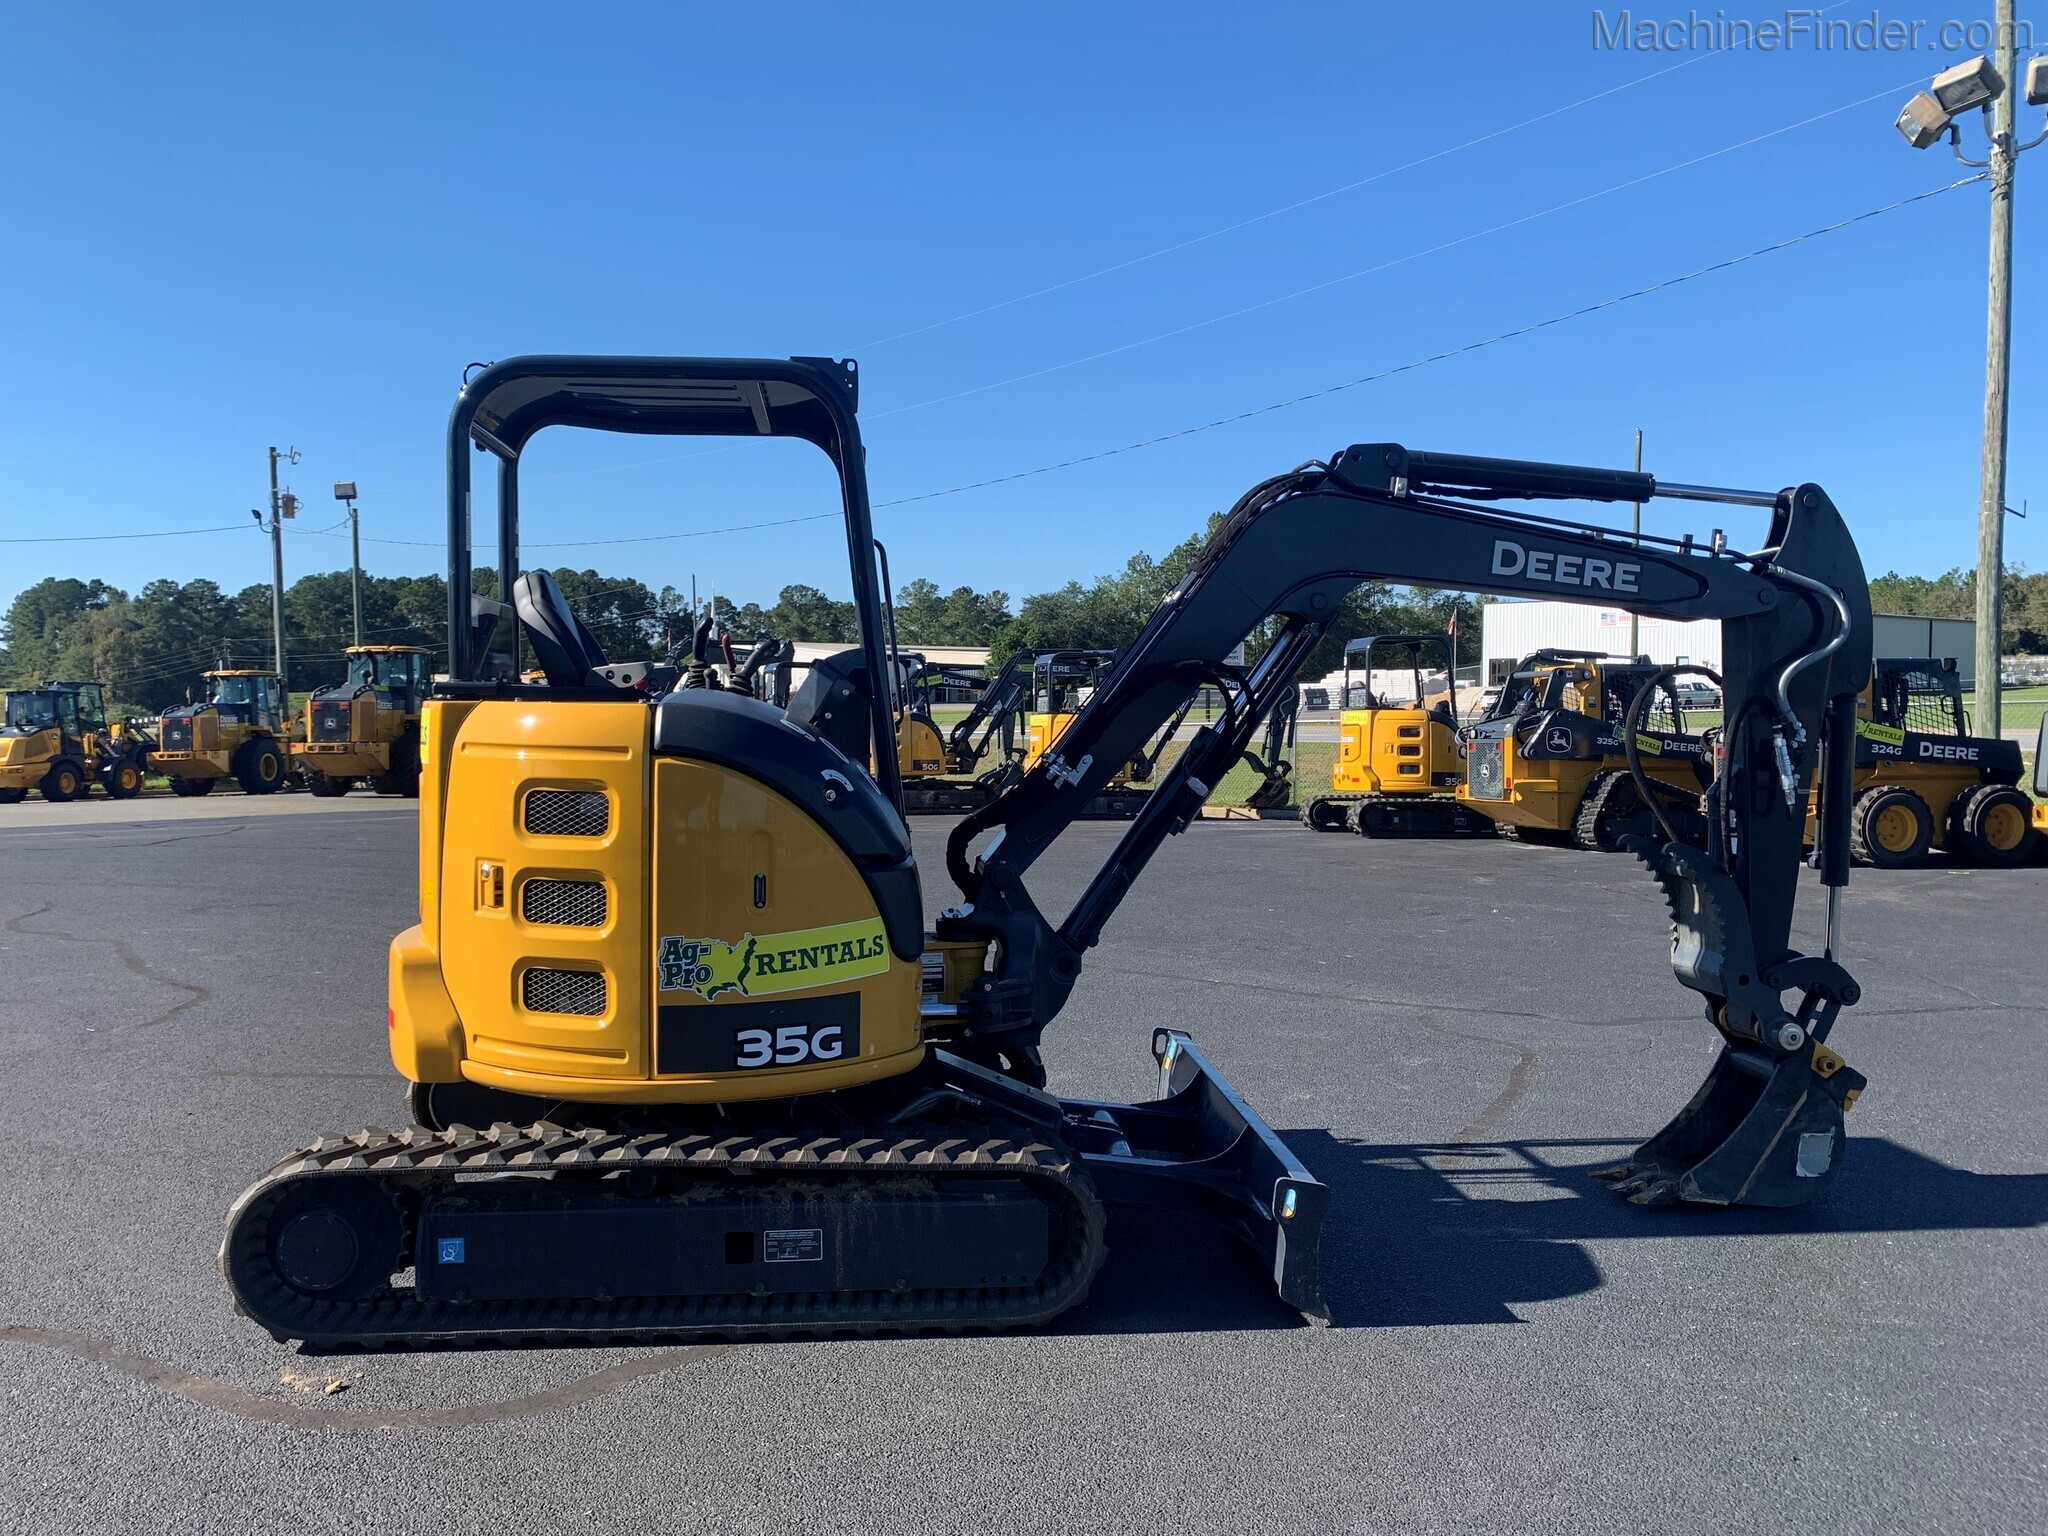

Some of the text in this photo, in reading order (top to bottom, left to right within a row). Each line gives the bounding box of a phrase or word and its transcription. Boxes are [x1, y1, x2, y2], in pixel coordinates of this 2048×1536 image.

[1491, 540, 1641, 593] DEERE
[1039, 665, 1070, 673] DERE
[943, 677, 971, 687] DEERE
[1596, 737, 1619, 746] 325G
[1868, 727, 1903, 742] RENTALS
[1663, 740, 1703, 753] DEERE
[1871, 744, 1902, 756] 324G
[1919, 741, 1979, 760] DEERE
[922, 763, 938, 771] 50G
[661, 938, 710, 965] Ag-
[755, 934, 884, 976] RENTALS
[662, 963, 713, 988] Pro
[737, 1026, 842, 1067] 35G
